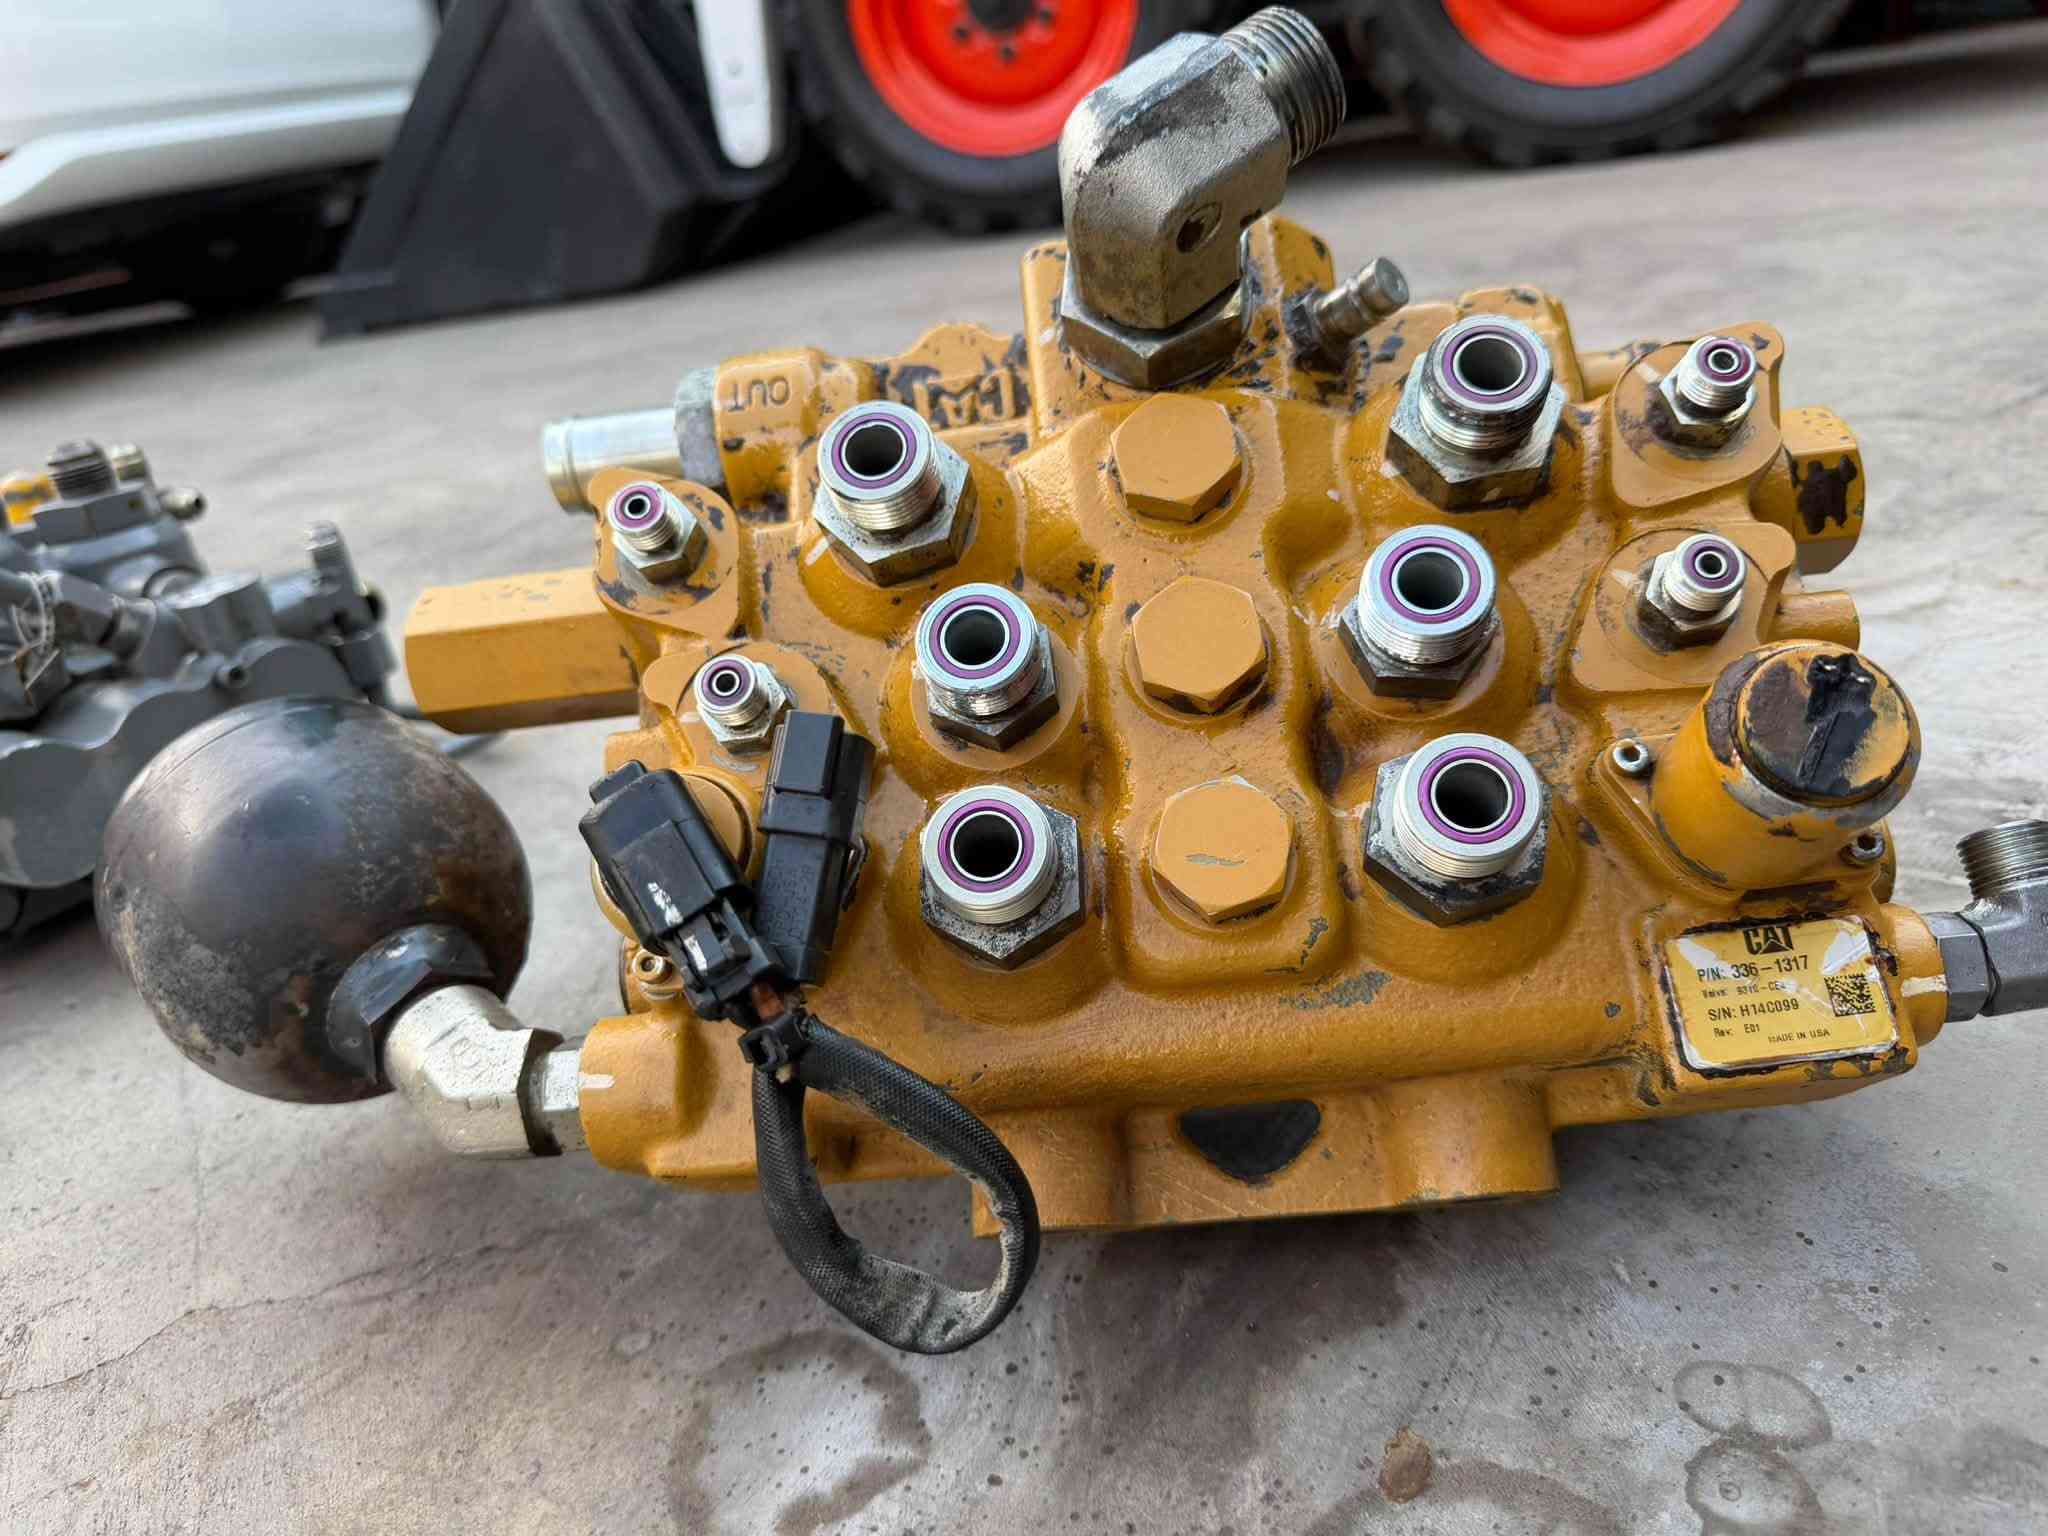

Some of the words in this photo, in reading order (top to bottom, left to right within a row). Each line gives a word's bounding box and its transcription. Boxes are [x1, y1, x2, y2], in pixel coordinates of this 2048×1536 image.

[728, 375, 792, 412] OUT
[1743, 927, 1794, 955] CAT
[1697, 967, 1726, 982] P/N:
[1731, 955, 1809, 979] 336-1317
[1708, 1006, 1737, 1021] S/N:
[1739, 998, 1799, 1017] H14C099
[1768, 1032, 1793, 1044] MADE
[1796, 1031, 1806, 1041] IN
[1810, 1028, 1831, 1040] USA
